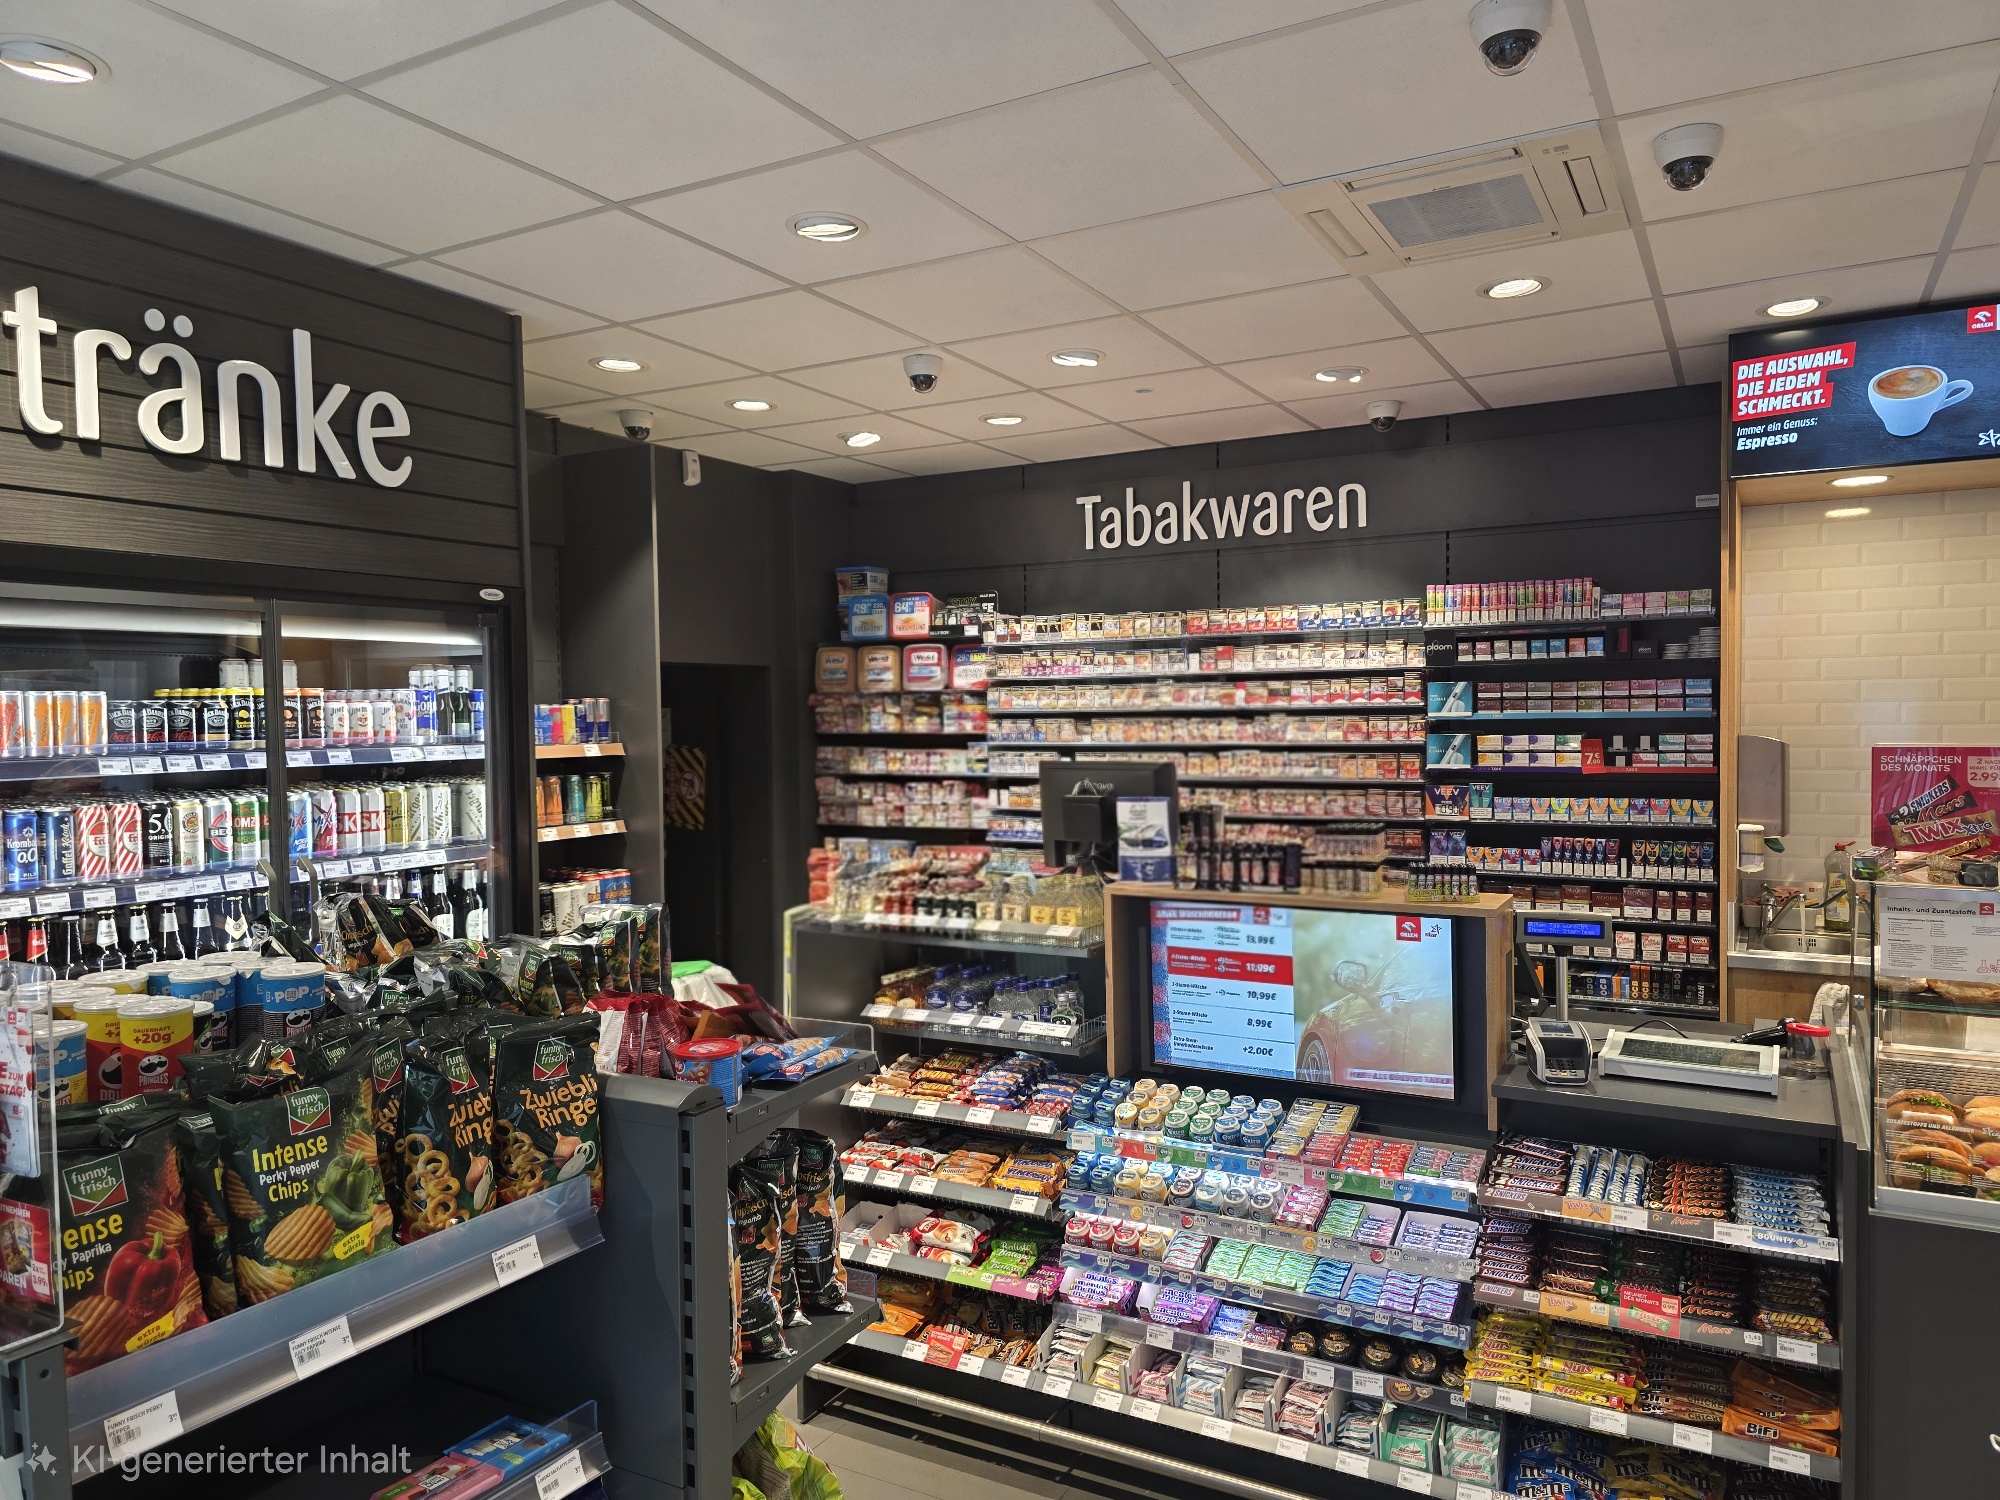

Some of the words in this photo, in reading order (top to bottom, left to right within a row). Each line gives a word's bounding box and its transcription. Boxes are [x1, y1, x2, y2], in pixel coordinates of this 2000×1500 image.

[1737, 362, 1764, 381] DIE
[1766, 348, 1849, 375] AUSWAHL,
[2, 286, 413, 488] tränke
[1737, 380, 1764, 399] DIE
[1767, 371, 1822, 394] JEDEM
[1737, 389, 1826, 416] SCHMECKT.
[1737, 423, 1766, 437] Immer
[1767, 421, 1781, 432] ein
[1737, 431, 1798, 451] Espresso
[1076, 481, 1367, 549] Tabakwaren
[1426, 640, 1452, 656] ploom
[1880, 753, 1962, 764] SCHNÄPPCHEN
[1880, 763, 1902, 772] DES
[1904, 764, 1951, 772] MONATS
[1434, 787, 1459, 796] VEEV
[1909, 780, 1950, 813] SNICKERS
[1918, 795, 1965, 822] Mars
[1931, 907, 1977, 916] Zusatzstoffe
[1246, 990, 1277, 1001] 10,99€
[1599, 978, 1607, 996] OCB
[1631, 981, 1639, 998] OCB
[1641, 981, 1649, 999] OCB
[1246, 1018, 1273, 1029] 8,99€
[1242, 1045, 1274, 1057] +2,00€
[138, 1072, 169, 1086] PRINGLES
[289, 1091, 322, 1110] funny-
[520, 1074, 598, 1111] Zwiebli
[296, 1099, 324, 1118] frisch
[536, 1097, 598, 1130] Ringe
[252, 1134, 329, 1175] Intense
[71, 1168, 112, 1188] funny-
[259, 1168, 288, 1186] Perky
[289, 1158, 321, 1179] Pepper
[79, 1174, 117, 1196] frisch
[268, 1177, 310, 1203] Chips
[1509, 1176, 1557, 1190] SNICKERS
[1494, 1190, 1526, 1200] SNICKERS
[1670, 1216, 1701, 1226] Mars
[341, 1232, 361, 1249] extra
[1757, 1231, 1796, 1244] BOUNTY
[71, 1241, 112, 1263] Paprika
[341, 1238, 366, 1257] würzig
[1078, 1280, 1109, 1291] mentos
[1481, 1284, 1513, 1296] SNICKERS
[1697, 1323, 1733, 1335] Mars
